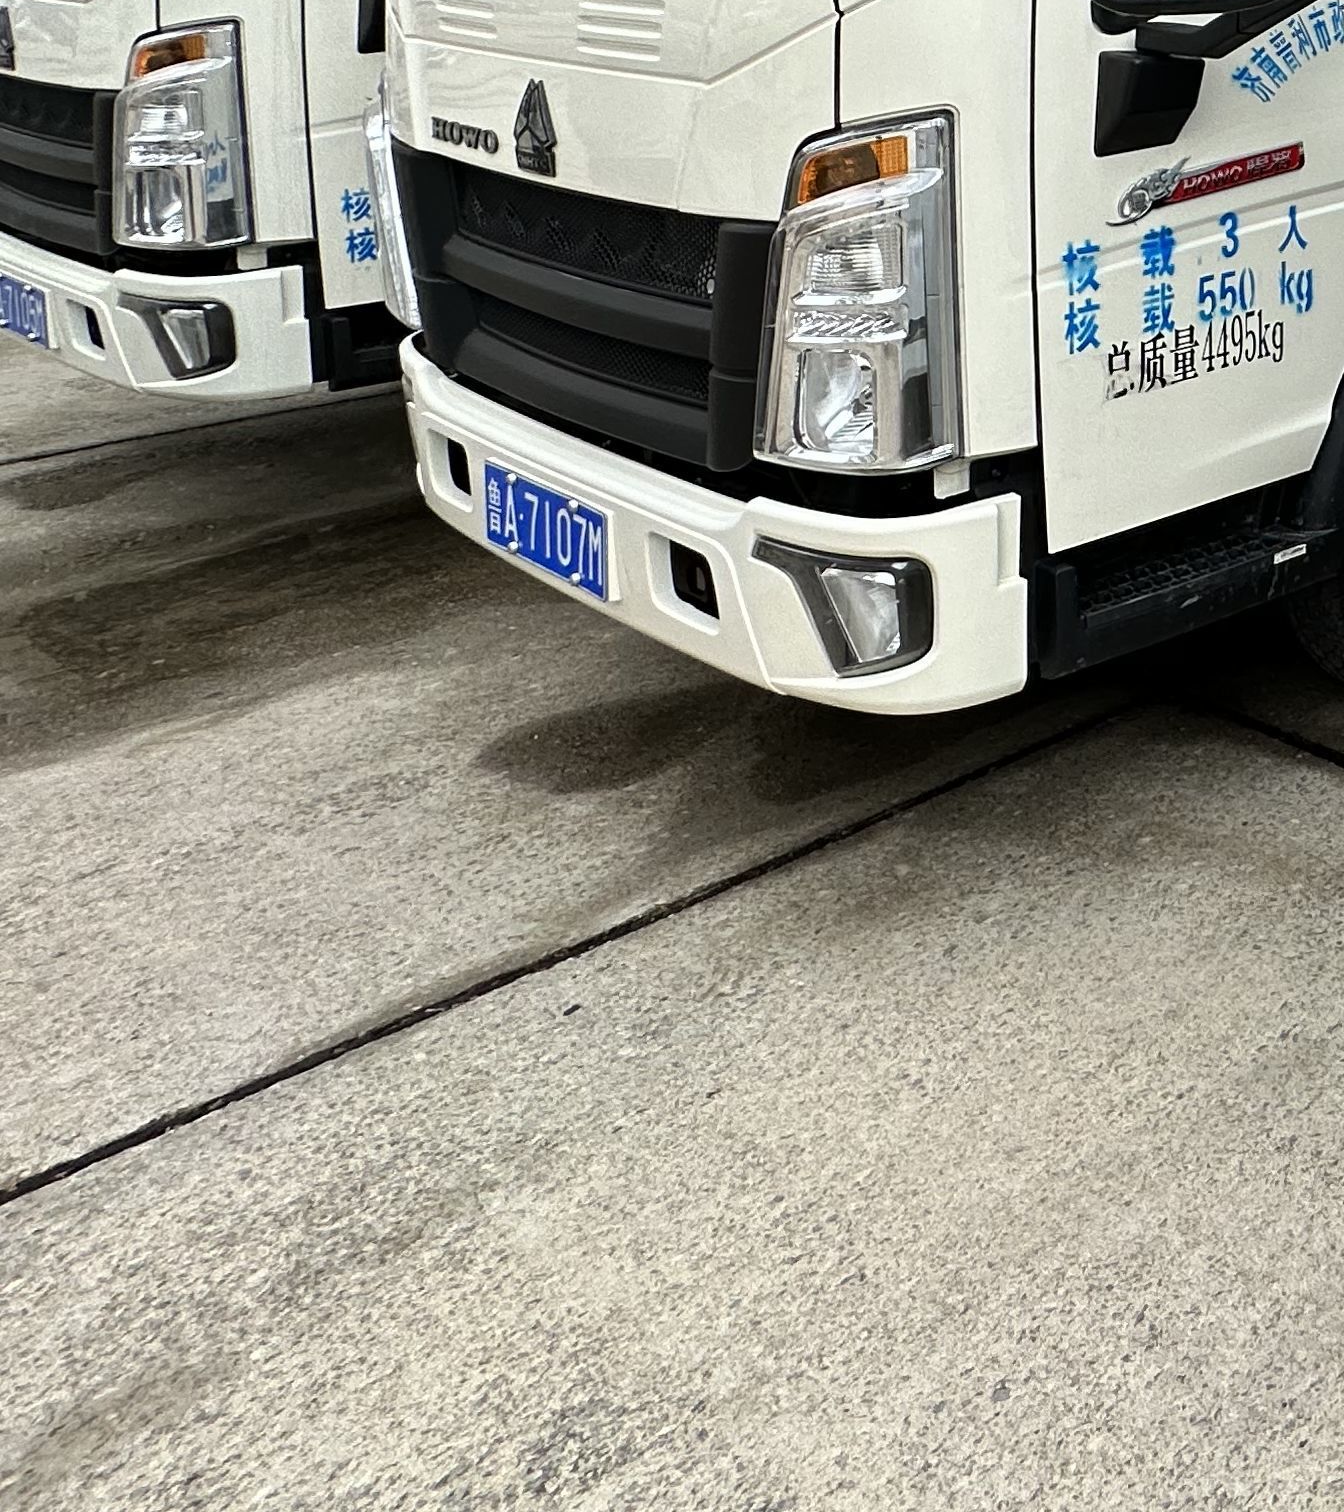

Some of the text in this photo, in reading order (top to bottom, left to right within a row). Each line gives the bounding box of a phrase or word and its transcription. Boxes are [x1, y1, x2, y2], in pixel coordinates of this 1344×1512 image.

[431, 116, 499, 154] HOWO
[1197, 266, 1256, 323] 550
[1279, 261, 1314, 315] kg
